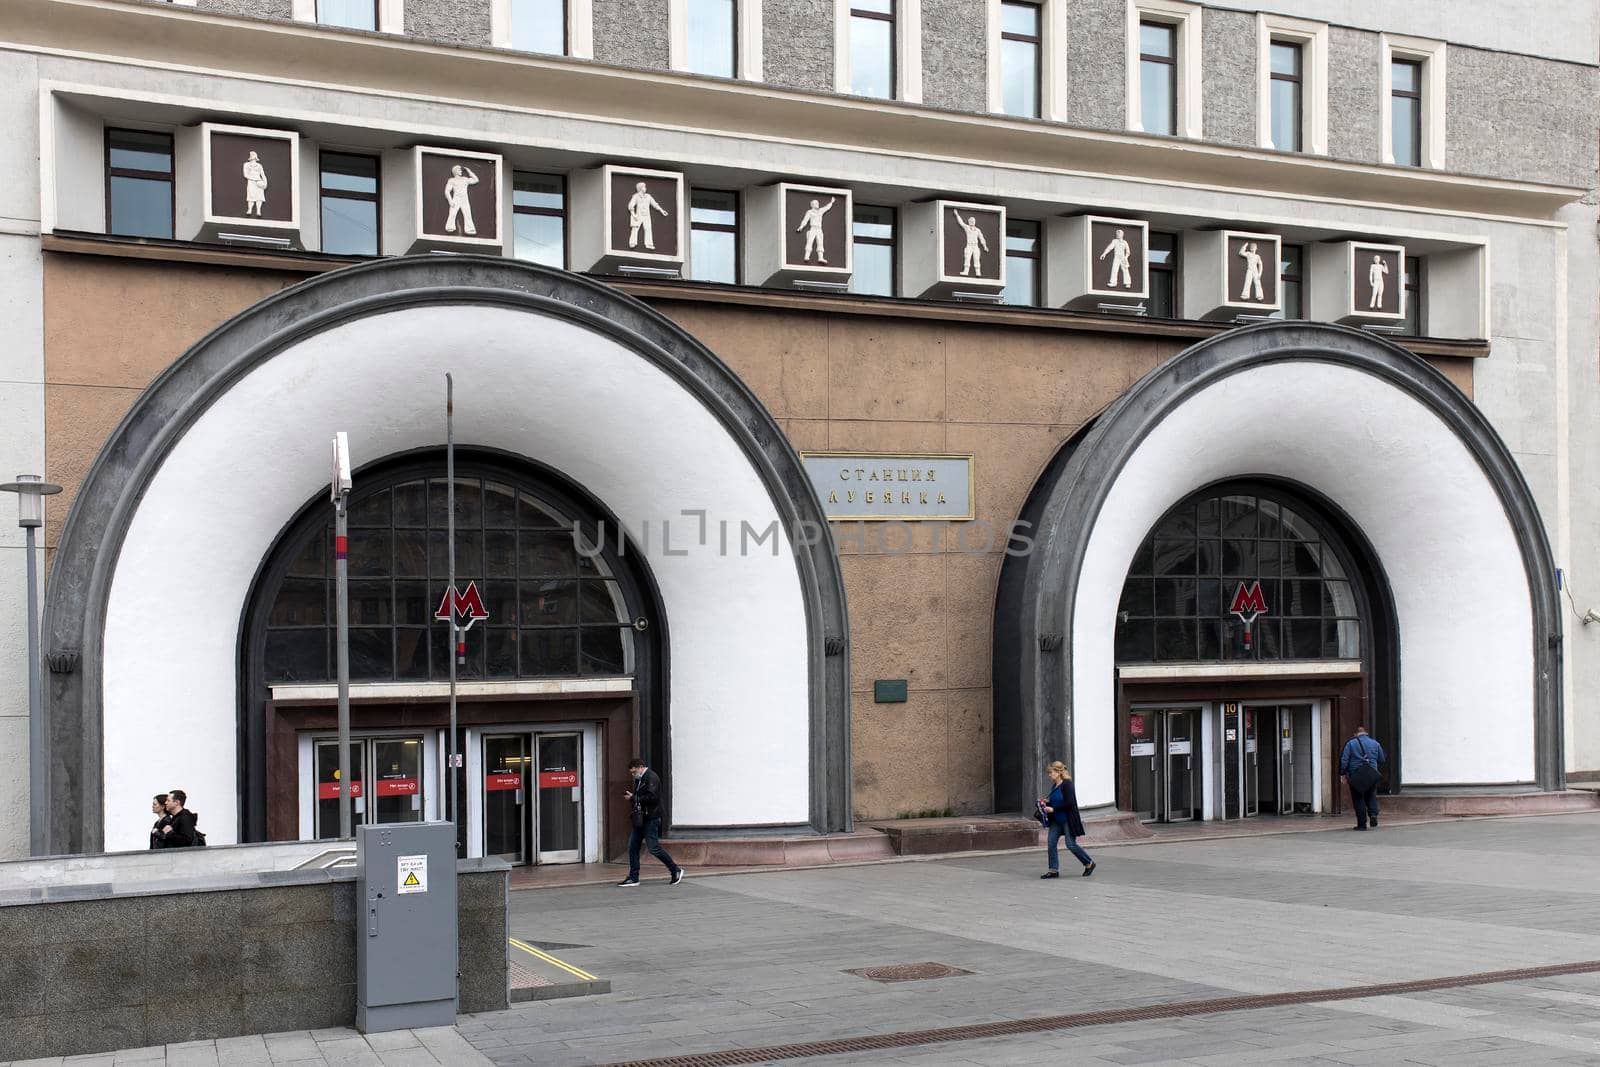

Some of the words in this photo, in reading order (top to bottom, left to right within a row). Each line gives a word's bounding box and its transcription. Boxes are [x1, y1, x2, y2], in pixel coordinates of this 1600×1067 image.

[839, 469, 936, 482] СТАНЦИЯ
[828, 490, 947, 504] ЛУБЯНКА
[1230, 581, 1269, 613] М
[1225, 703, 1236, 713] 10
